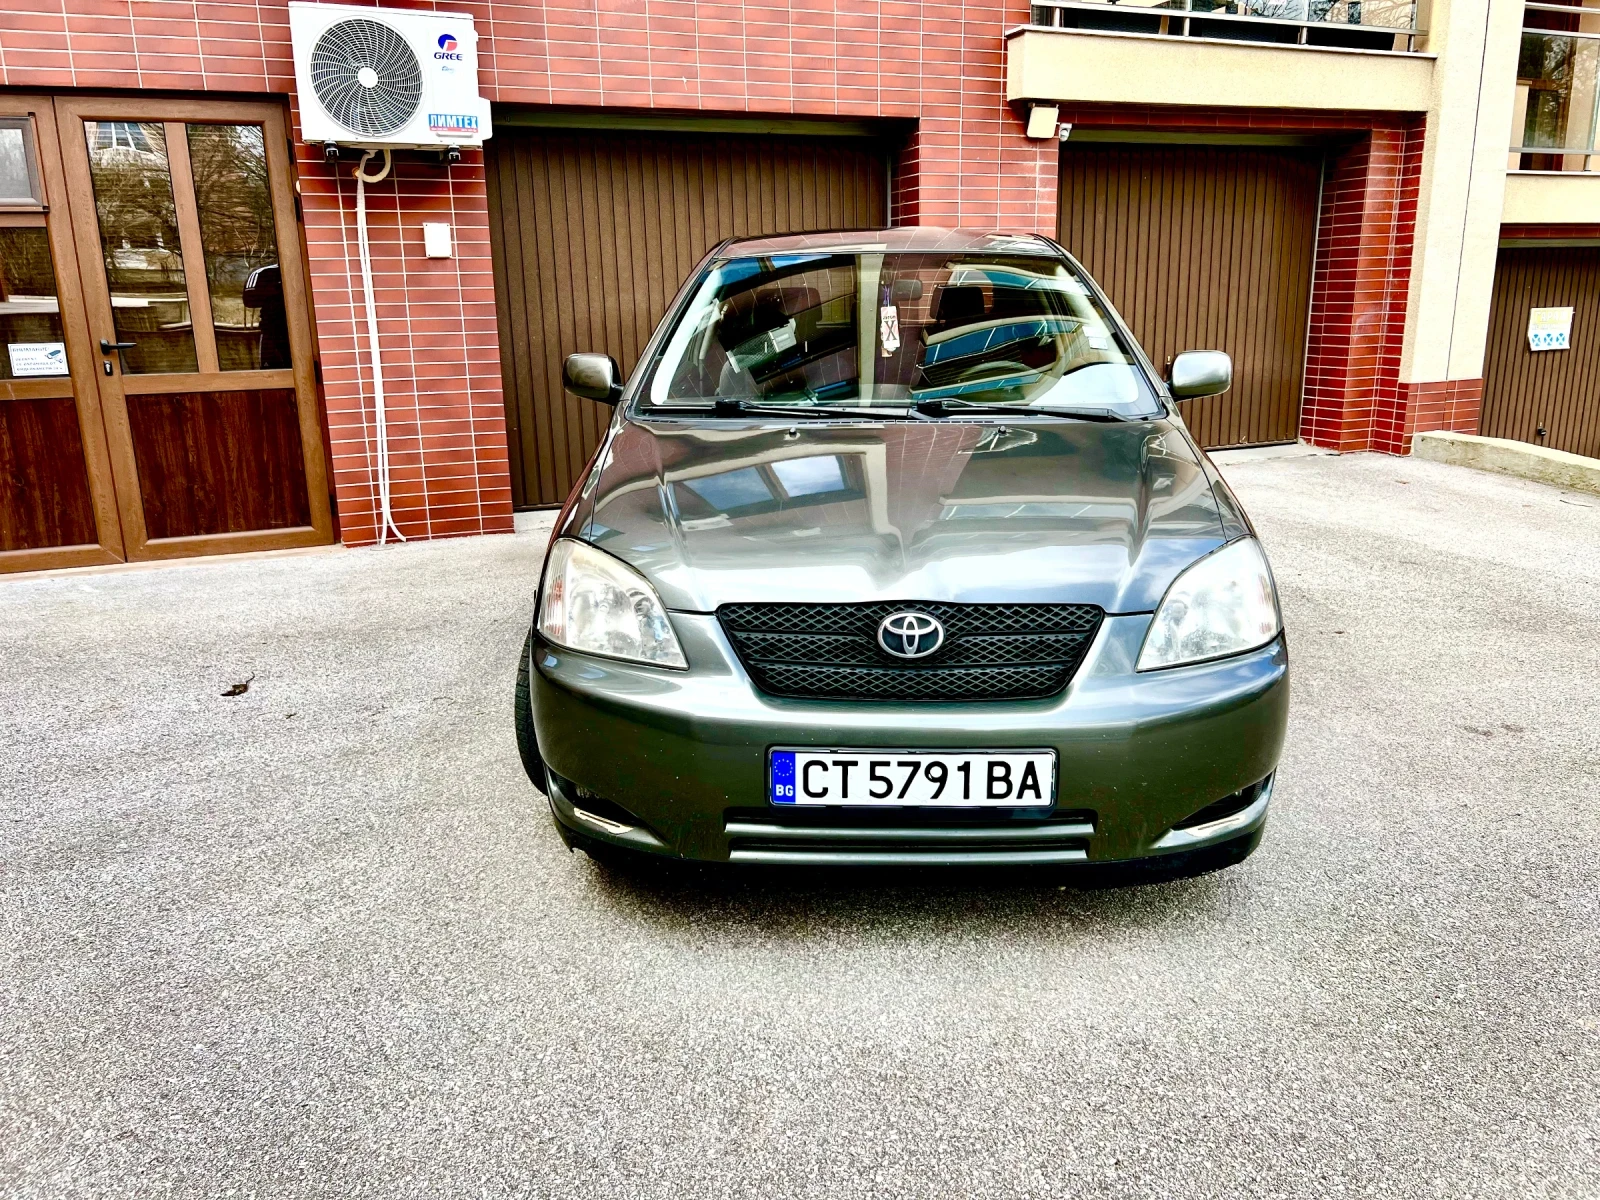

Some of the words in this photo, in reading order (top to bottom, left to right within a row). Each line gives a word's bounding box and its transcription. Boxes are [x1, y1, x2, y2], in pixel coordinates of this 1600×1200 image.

[433, 52, 463, 62] GREE
[430, 116, 477, 128] ЛИМТЕХ
[884, 320, 897, 341] X
[802, 760, 859, 799] CT
[869, 761, 971, 800] 5791
[986, 761, 1042, 800] BA
[775, 785, 794, 796] BG
